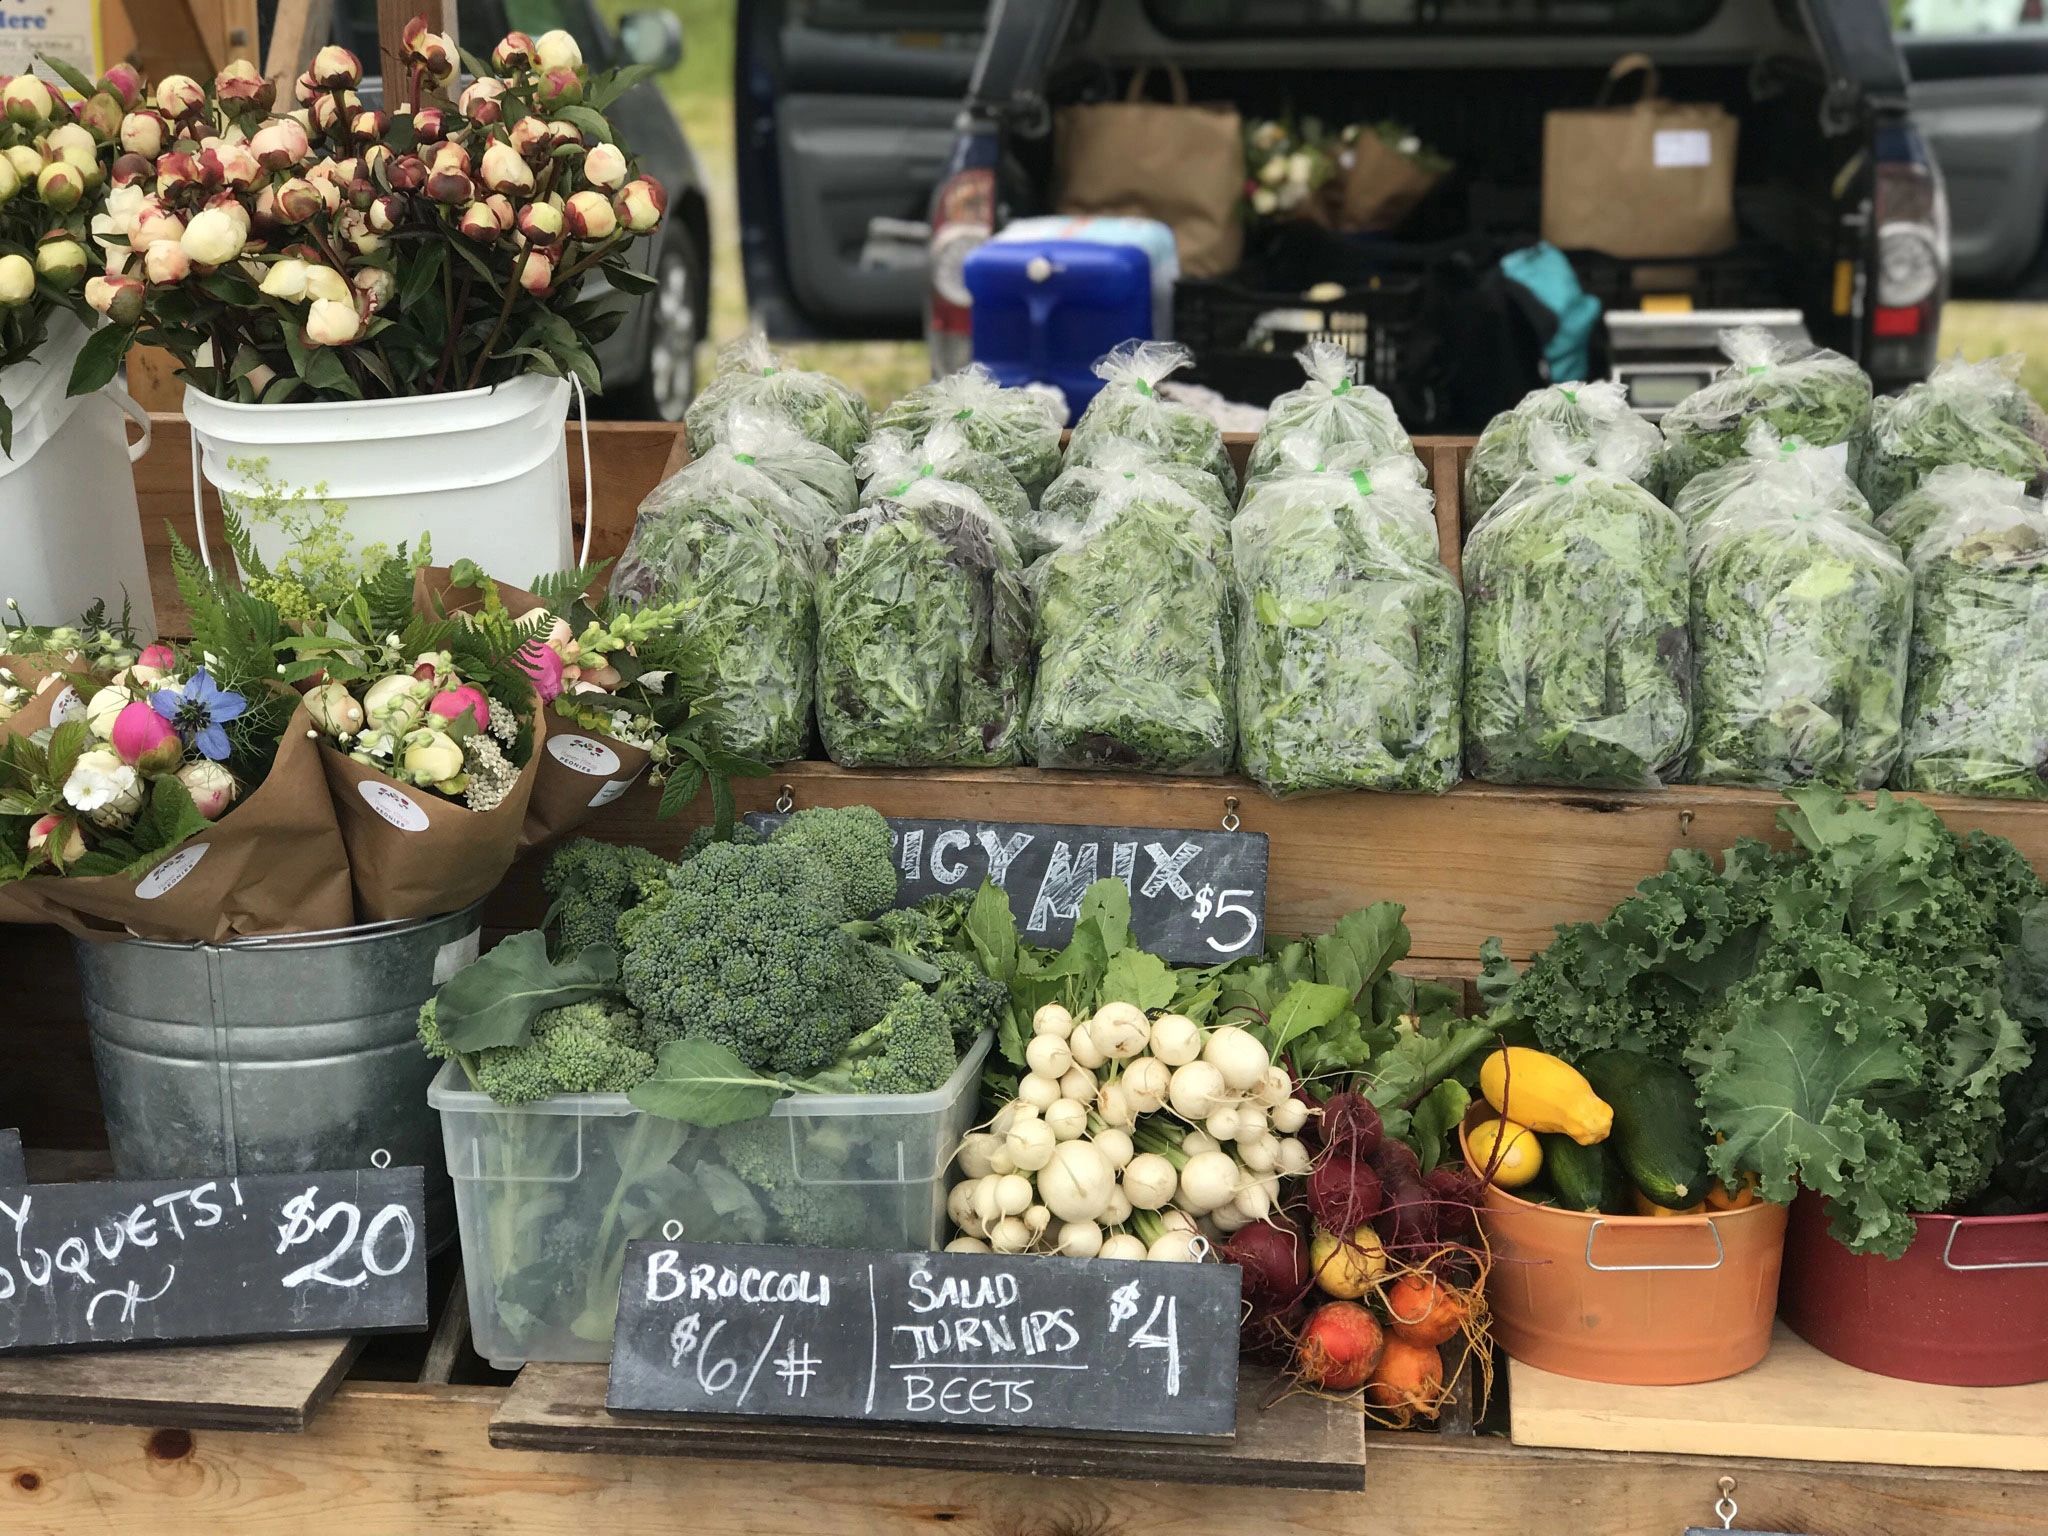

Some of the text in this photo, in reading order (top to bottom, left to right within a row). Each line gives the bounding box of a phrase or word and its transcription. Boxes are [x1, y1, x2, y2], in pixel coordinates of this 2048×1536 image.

[559, 756, 591, 773] PEONIES
[891, 828, 1203, 931] ICY MIX
[1191, 882, 1257, 953] $5
[276, 1185, 415, 1287] $20
[908, 1270, 1018, 1312] SALAD
[892, 1308, 1080, 1360] TURNIPS
[1109, 1279, 1179, 1396] $4
[903, 1374, 1034, 1414] BEETS
